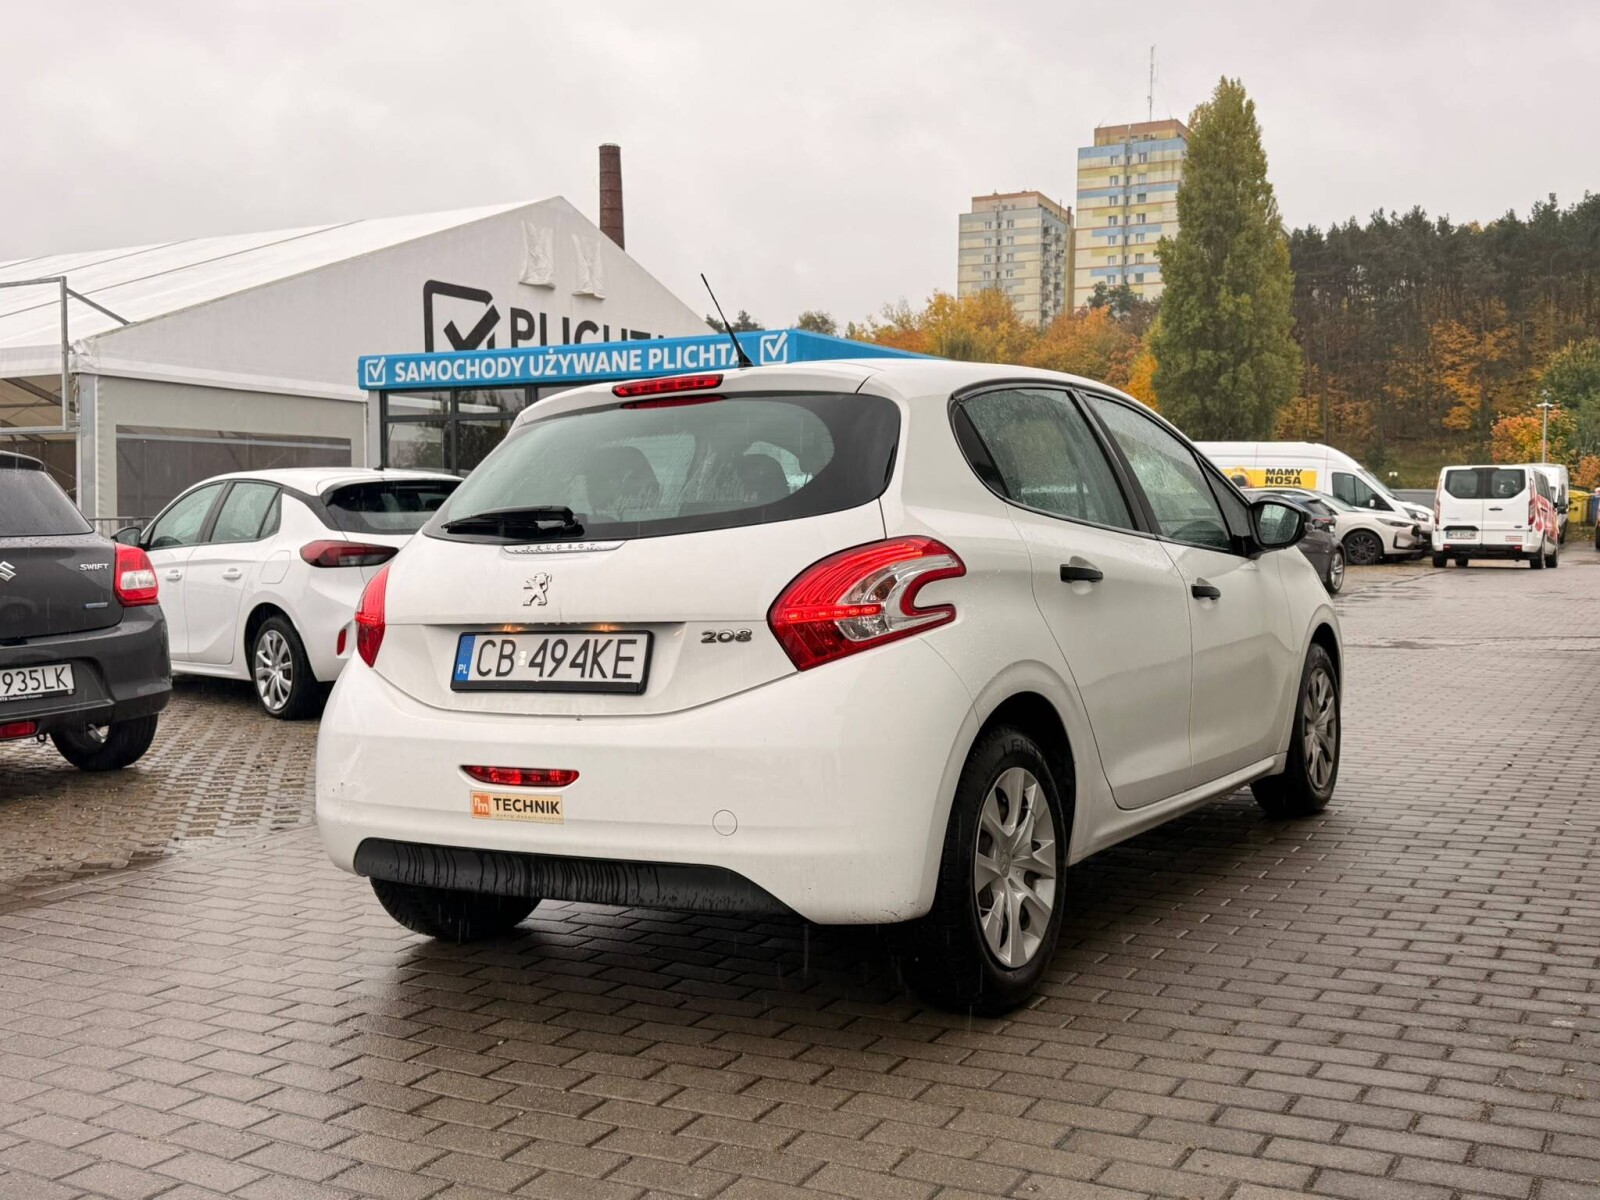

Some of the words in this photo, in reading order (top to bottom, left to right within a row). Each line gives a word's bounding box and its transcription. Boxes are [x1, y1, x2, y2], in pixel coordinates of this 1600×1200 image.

[395, 356, 524, 382] SAMOCHODY
[529, 349, 642, 376] UŻYWANE
[1266, 468, 1302, 476] MAMY
[1265, 476, 1302, 485] NOSA
[79, 563, 109, 571] SWIFT
[700, 628, 753, 644] 208
[476, 638, 516, 678] CB
[528, 638, 638, 679] 494KE
[457, 664, 468, 675] PL
[2, 666, 68, 694] 935LK
[493, 798, 560, 814] TECHNIK
